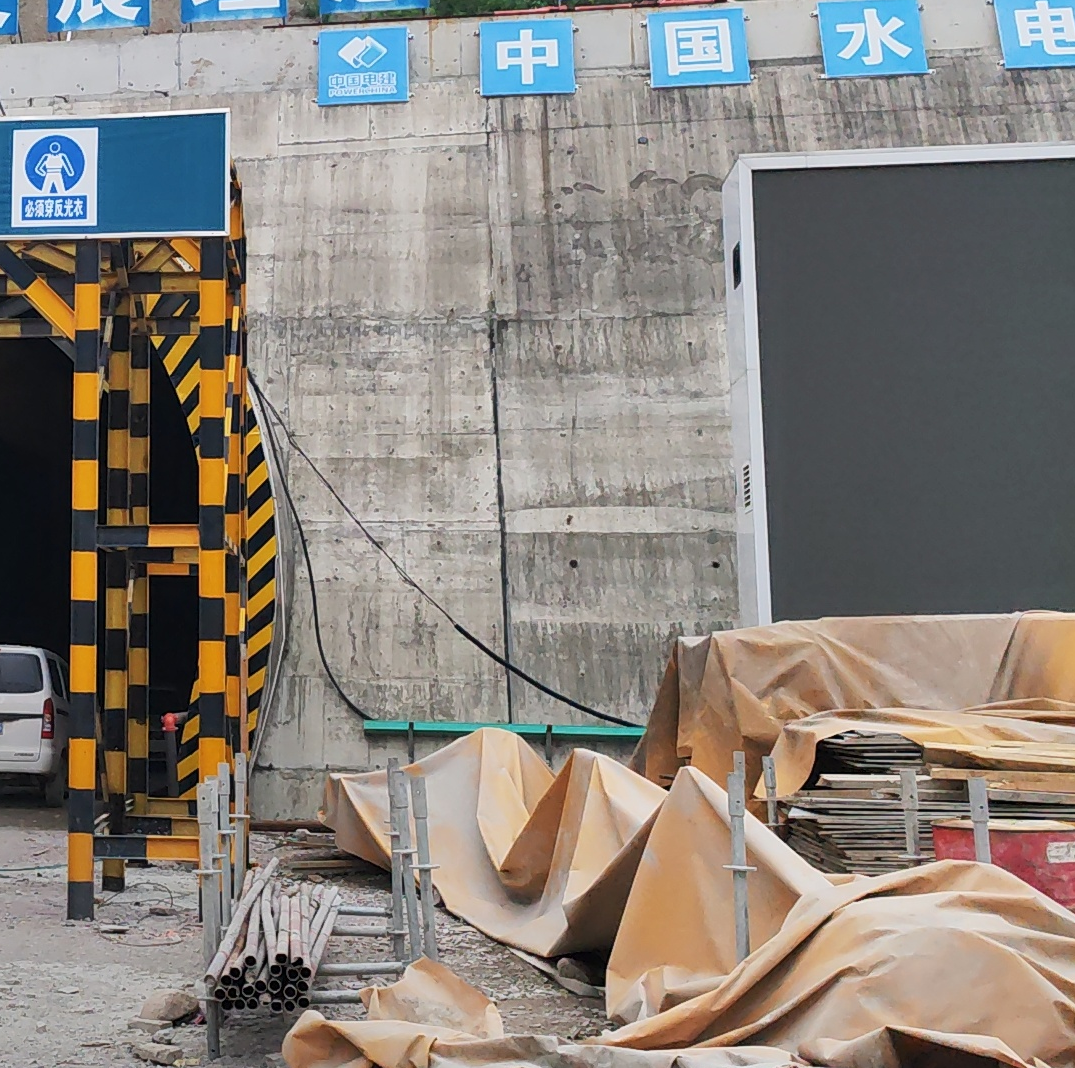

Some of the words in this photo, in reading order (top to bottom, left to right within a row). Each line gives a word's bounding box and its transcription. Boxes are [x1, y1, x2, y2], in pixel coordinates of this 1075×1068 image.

[328, 72, 396, 87] 中国电建
[329, 86, 397, 97] POWERCHINA
[24, 197, 84, 218] 必须穿反光衣
